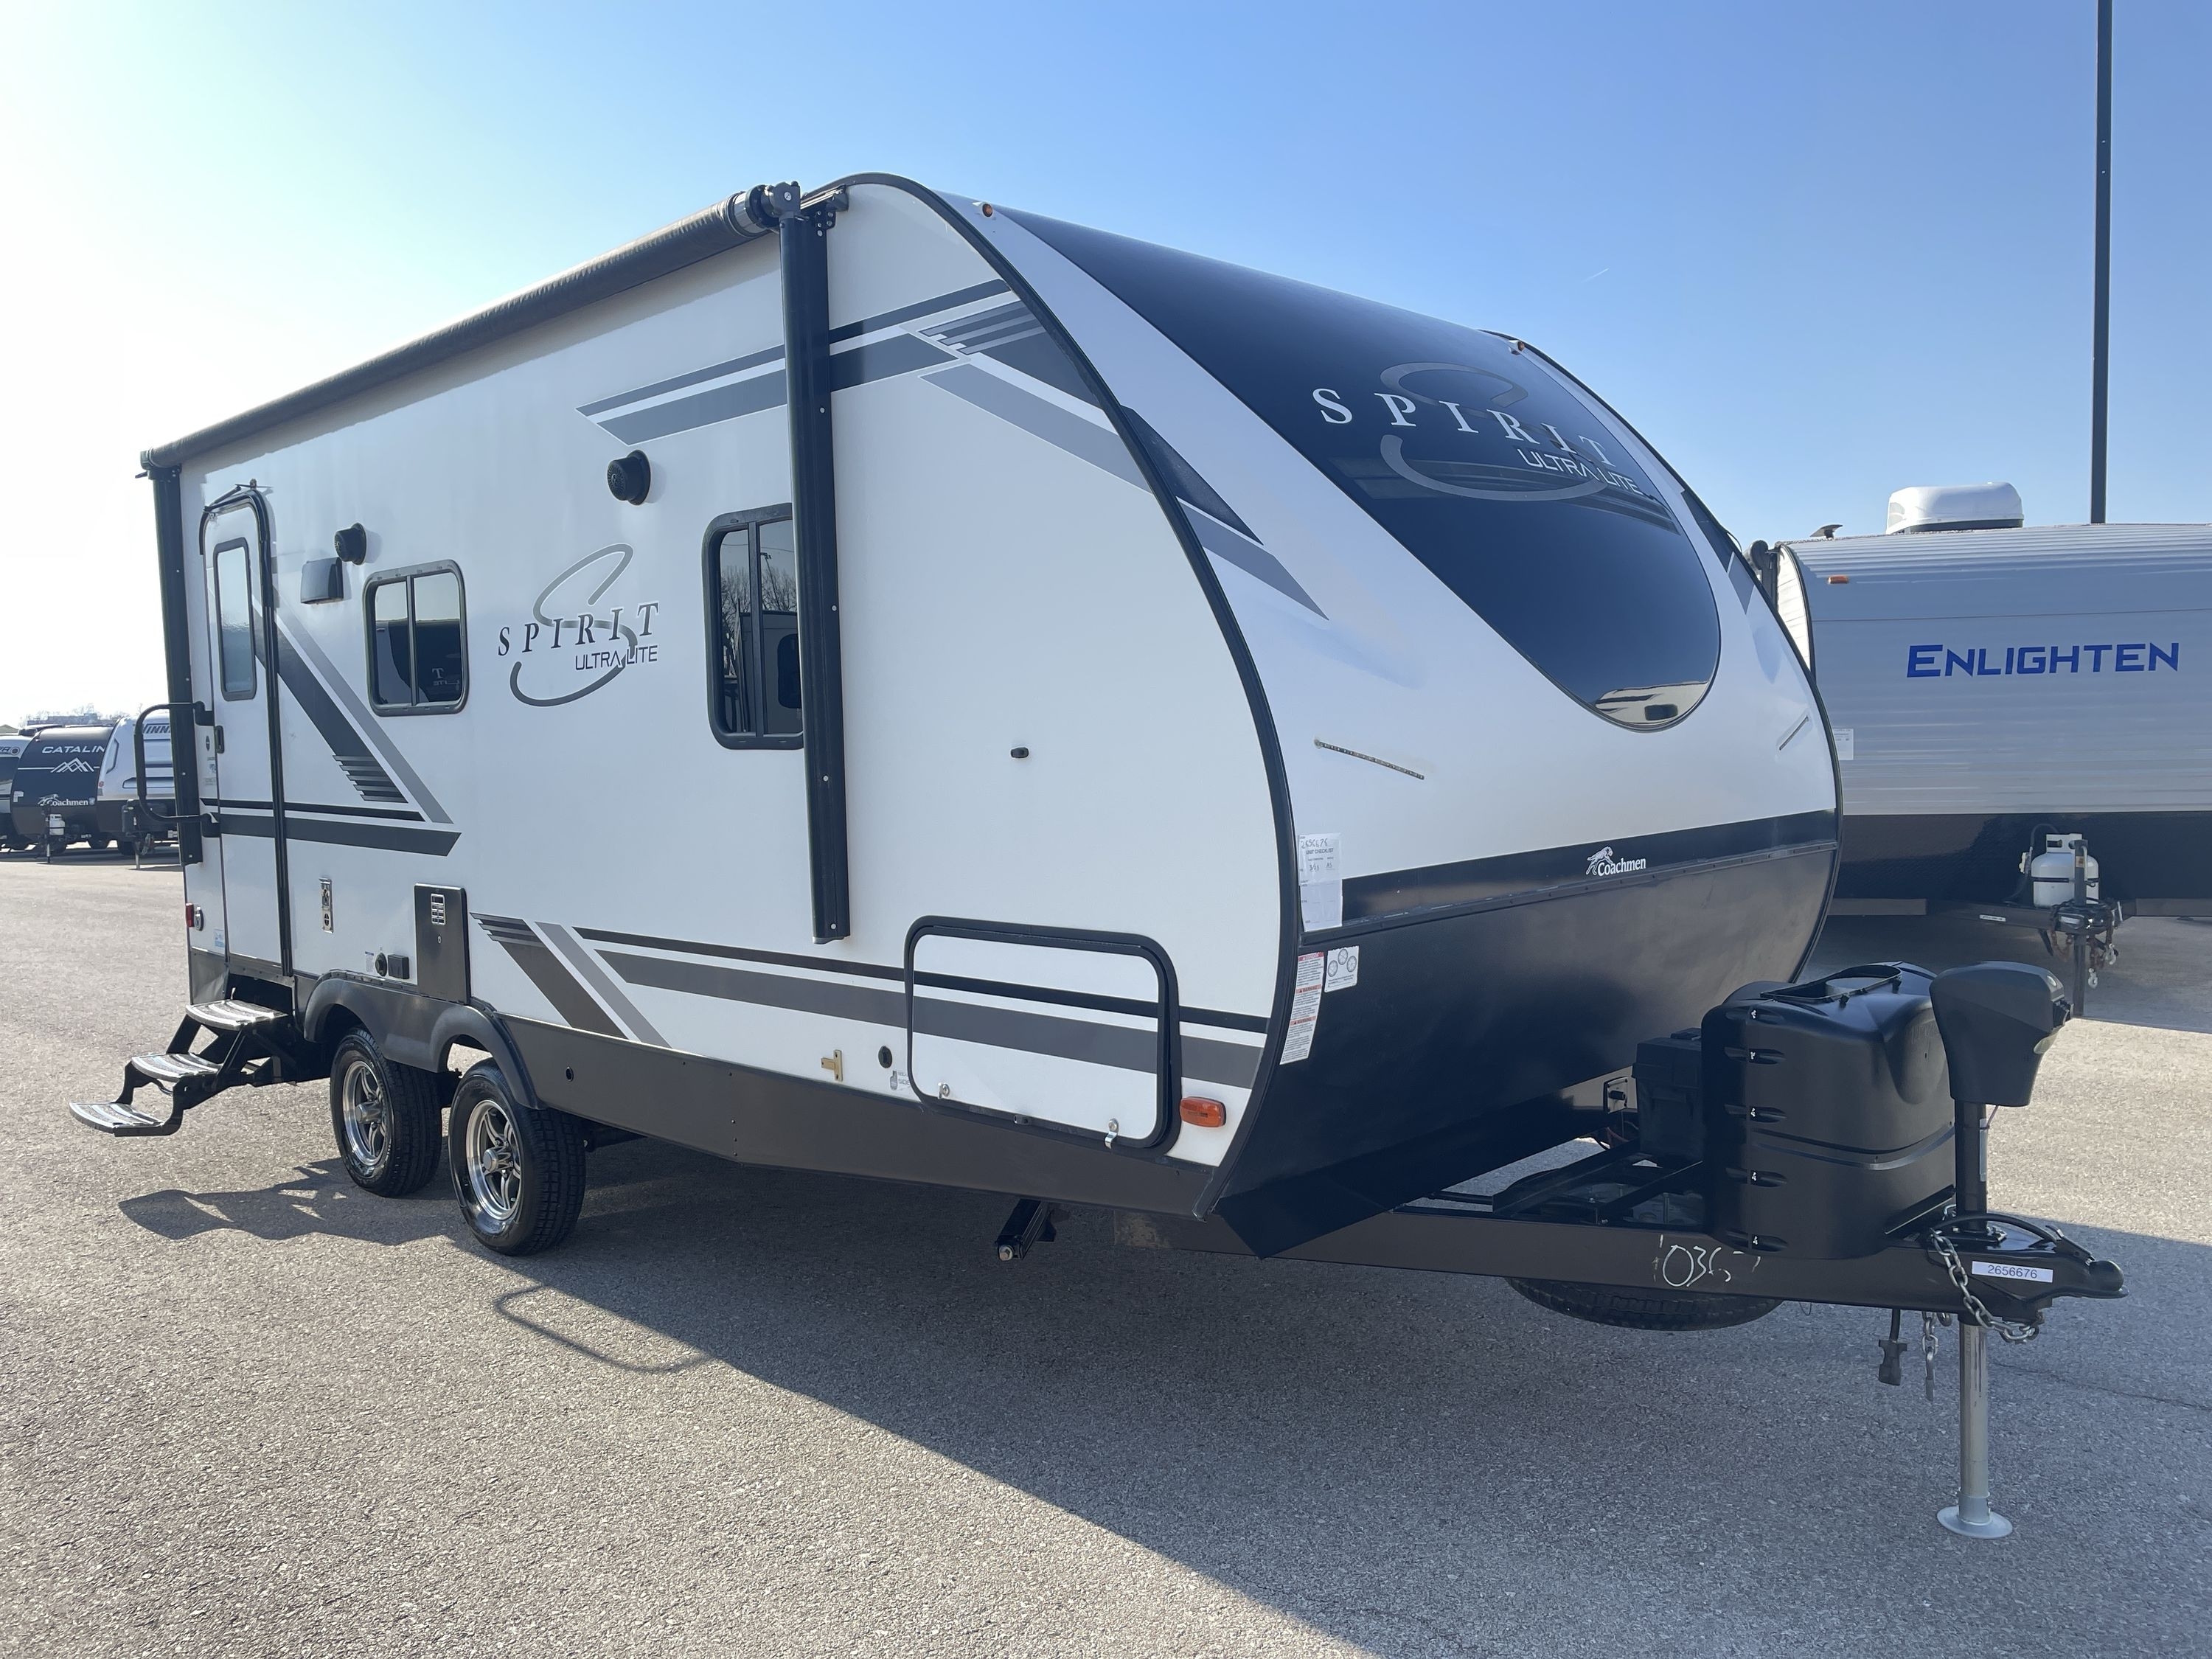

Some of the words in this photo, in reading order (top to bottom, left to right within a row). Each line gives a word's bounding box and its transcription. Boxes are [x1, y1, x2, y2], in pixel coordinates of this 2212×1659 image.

[1312, 388, 1615, 467] SPIRIT
[1517, 449, 1603, 481] ULTRA
[1601, 471, 1644, 495] LITE
[498, 602, 658, 656] SPIRIT
[575, 650, 621, 671] ULTRA
[626, 645, 658, 665] LITE
[1907, 642, 2180, 678] ENLIGHTEN
[41, 745, 105, 754] CATALIN
[46, 799, 88, 807] Coachmen
[1597, 858, 1646, 877] Coachmen
[1987, 1265, 2037, 1279] 2656676
